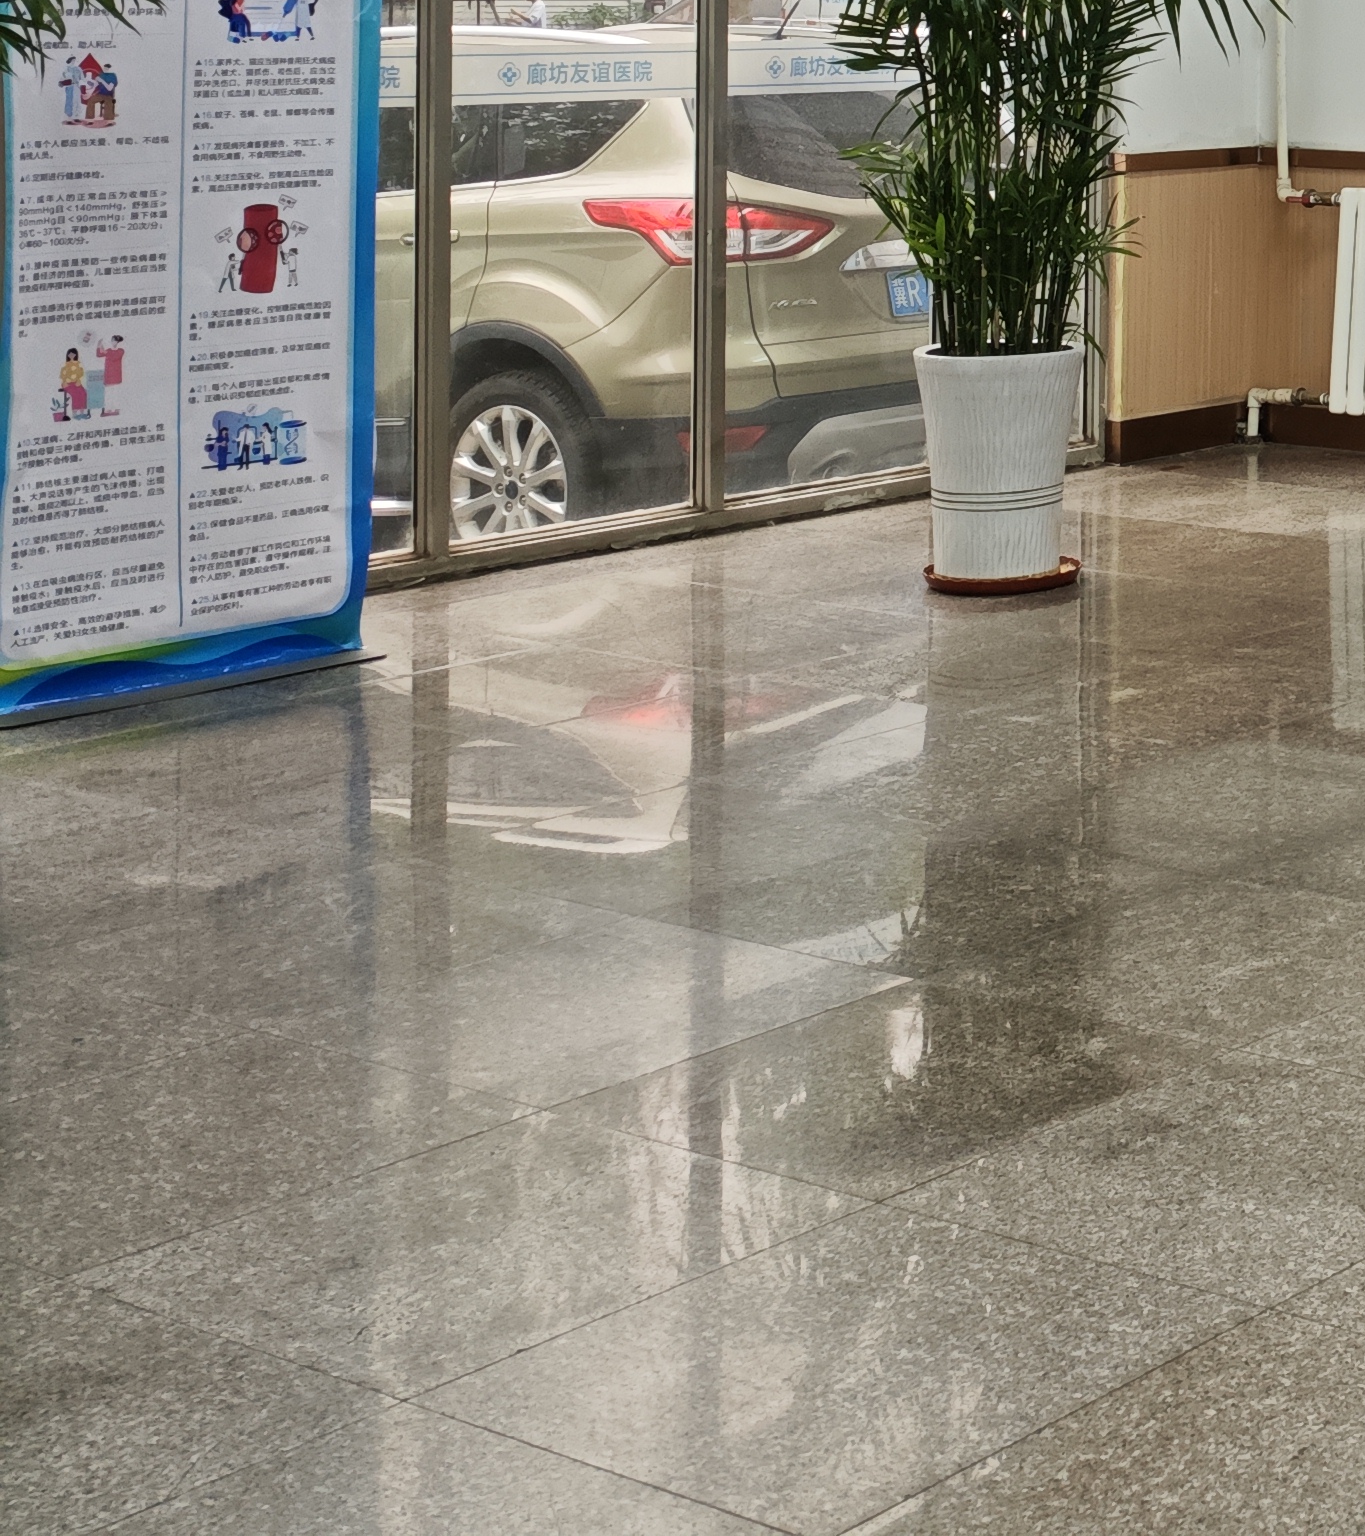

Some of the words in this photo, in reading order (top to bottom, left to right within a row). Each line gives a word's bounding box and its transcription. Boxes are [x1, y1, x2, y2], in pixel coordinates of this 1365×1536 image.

[526, 60, 653, 85] 廊坊友谊医院
